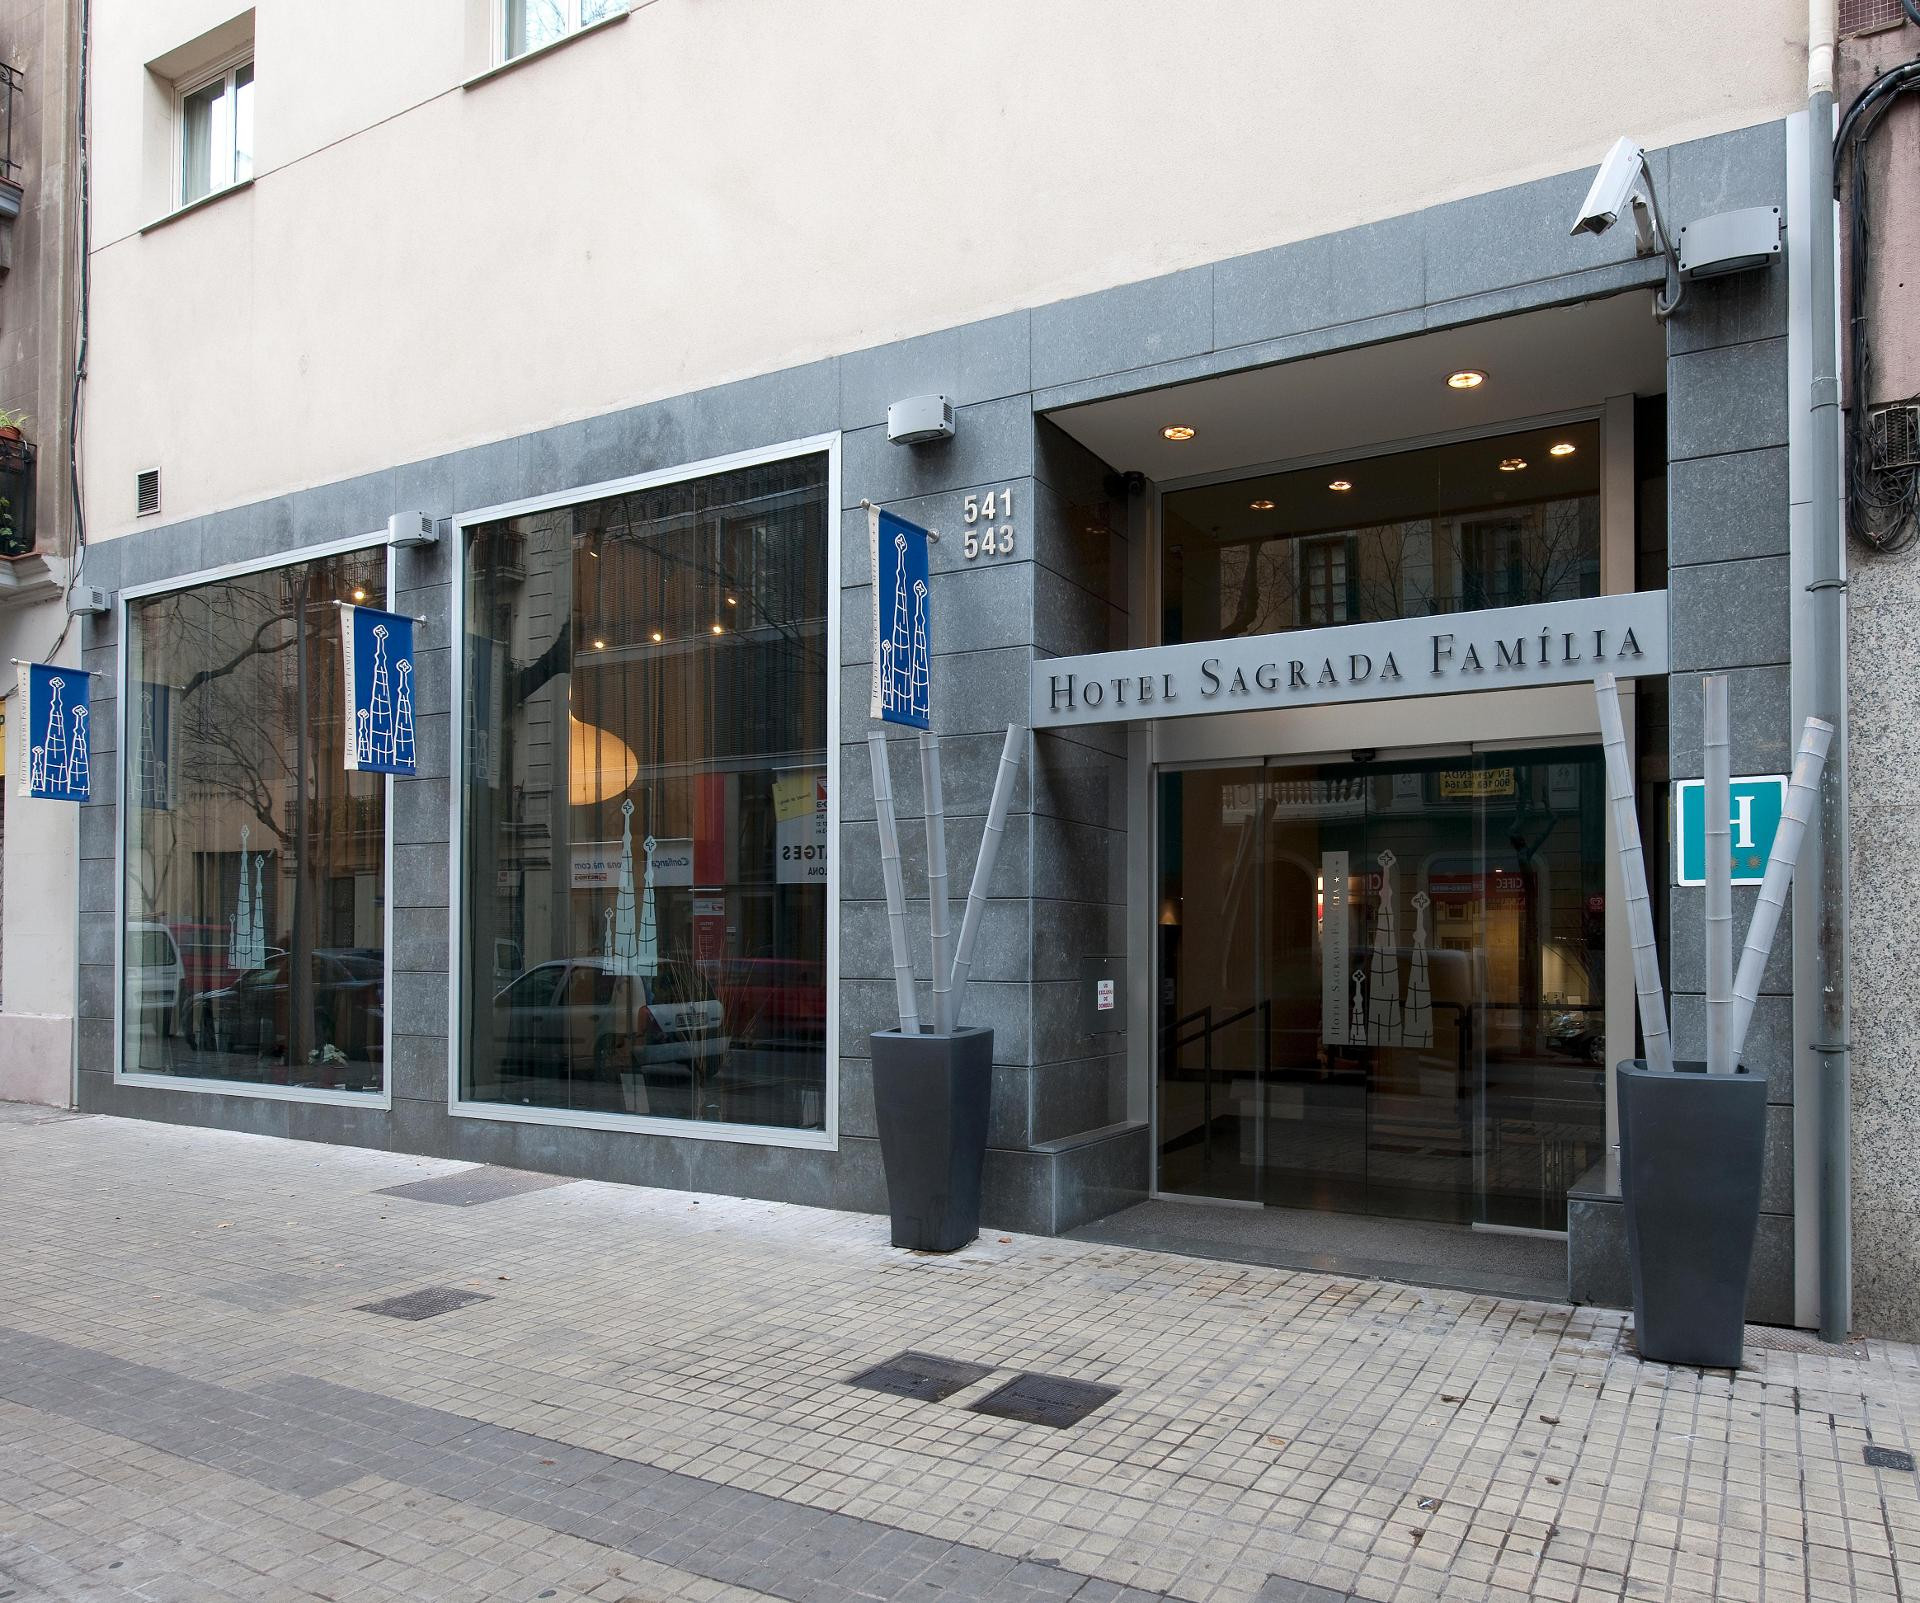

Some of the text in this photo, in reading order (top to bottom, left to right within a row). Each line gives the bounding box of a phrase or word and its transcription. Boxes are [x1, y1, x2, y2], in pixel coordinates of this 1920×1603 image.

[964, 488, 1012, 524] 541
[964, 524, 1014, 560] 543
[1049, 626, 1643, 711] HOTEL SAGRADA FAMÍLIA
